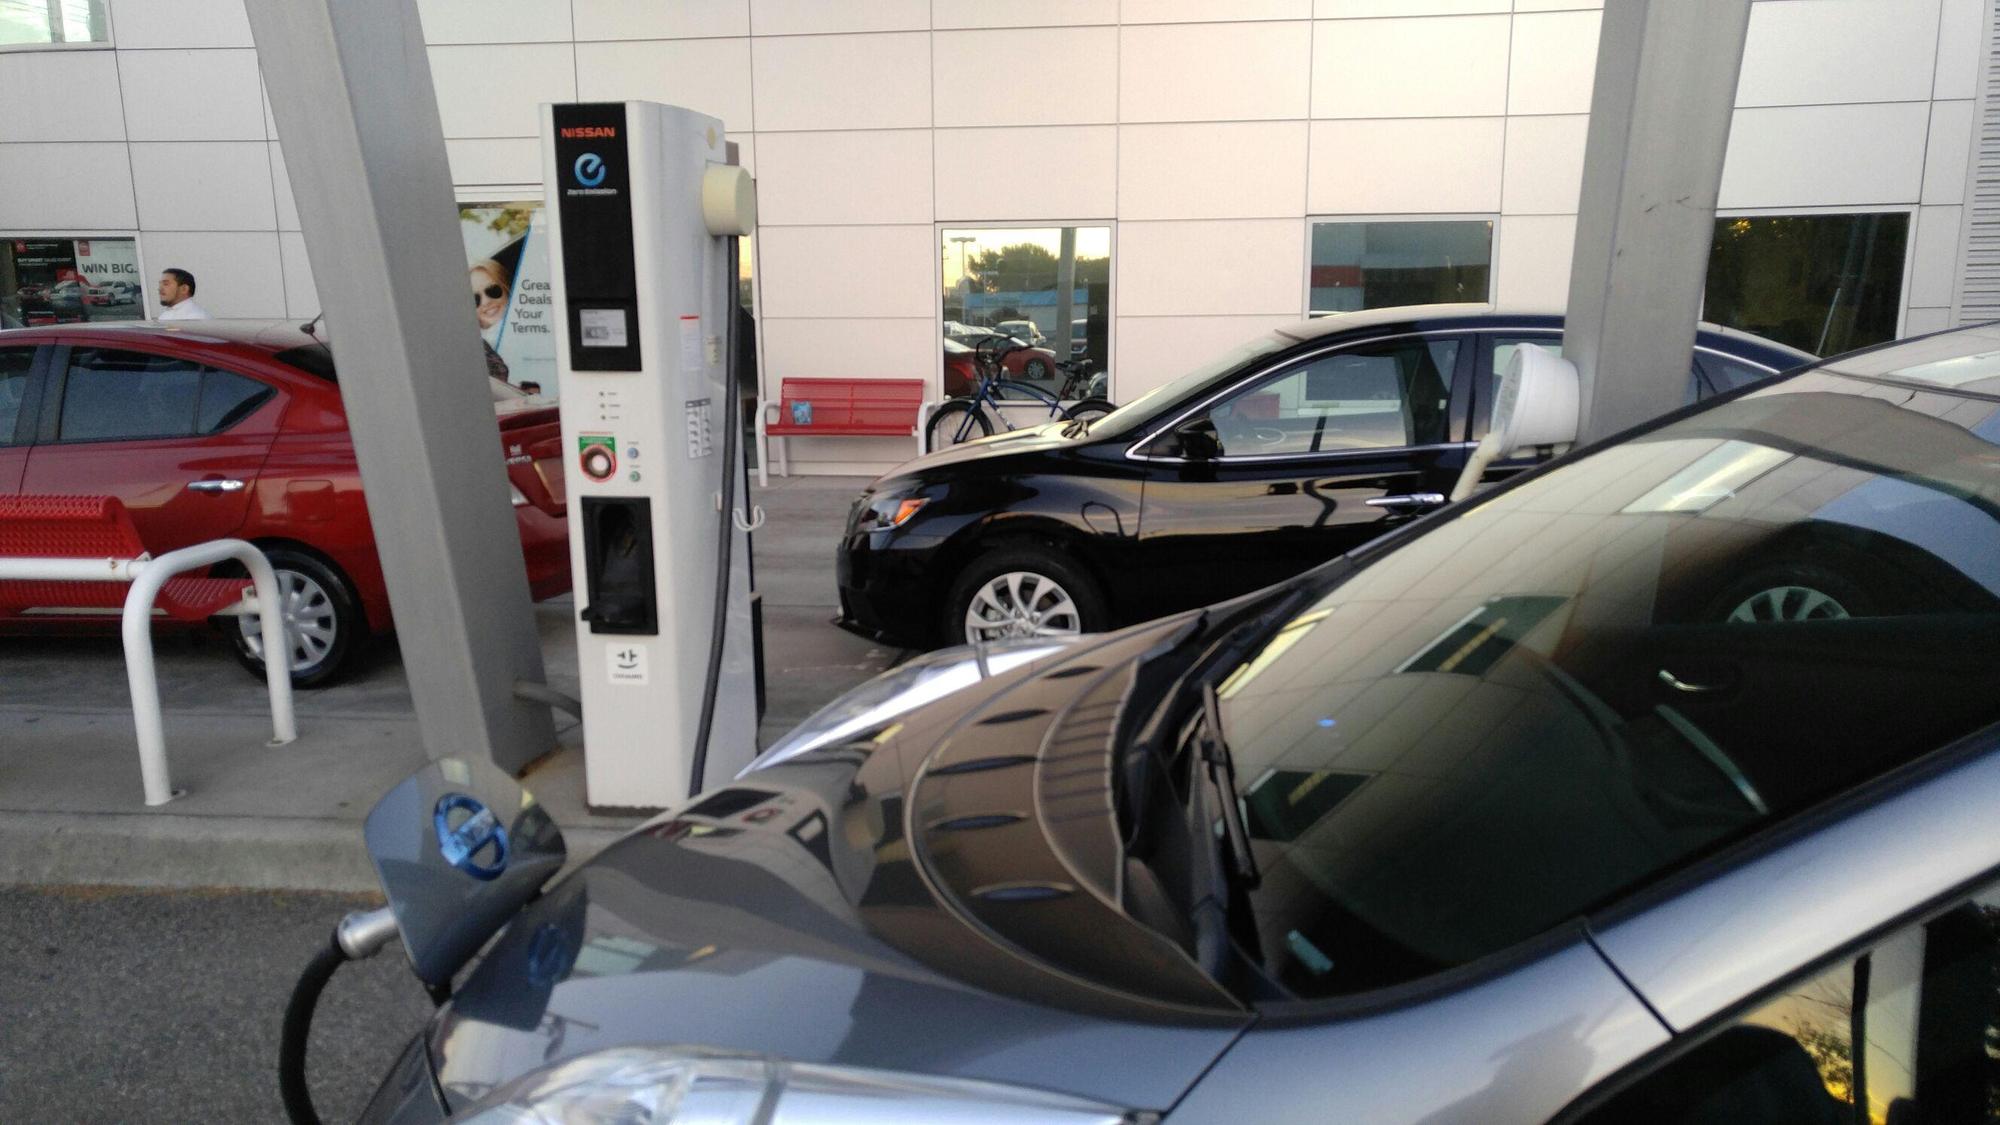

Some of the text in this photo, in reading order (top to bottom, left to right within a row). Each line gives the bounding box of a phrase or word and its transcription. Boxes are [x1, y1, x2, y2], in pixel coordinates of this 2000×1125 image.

[561, 127, 615, 138] NISSAN
[81, 263, 138, 274] WIN BIG.
[521, 279, 551, 291] Grea
[519, 293, 552, 305] Deals
[514, 308, 543, 319] Your
[510, 322, 551, 333] Terms.
